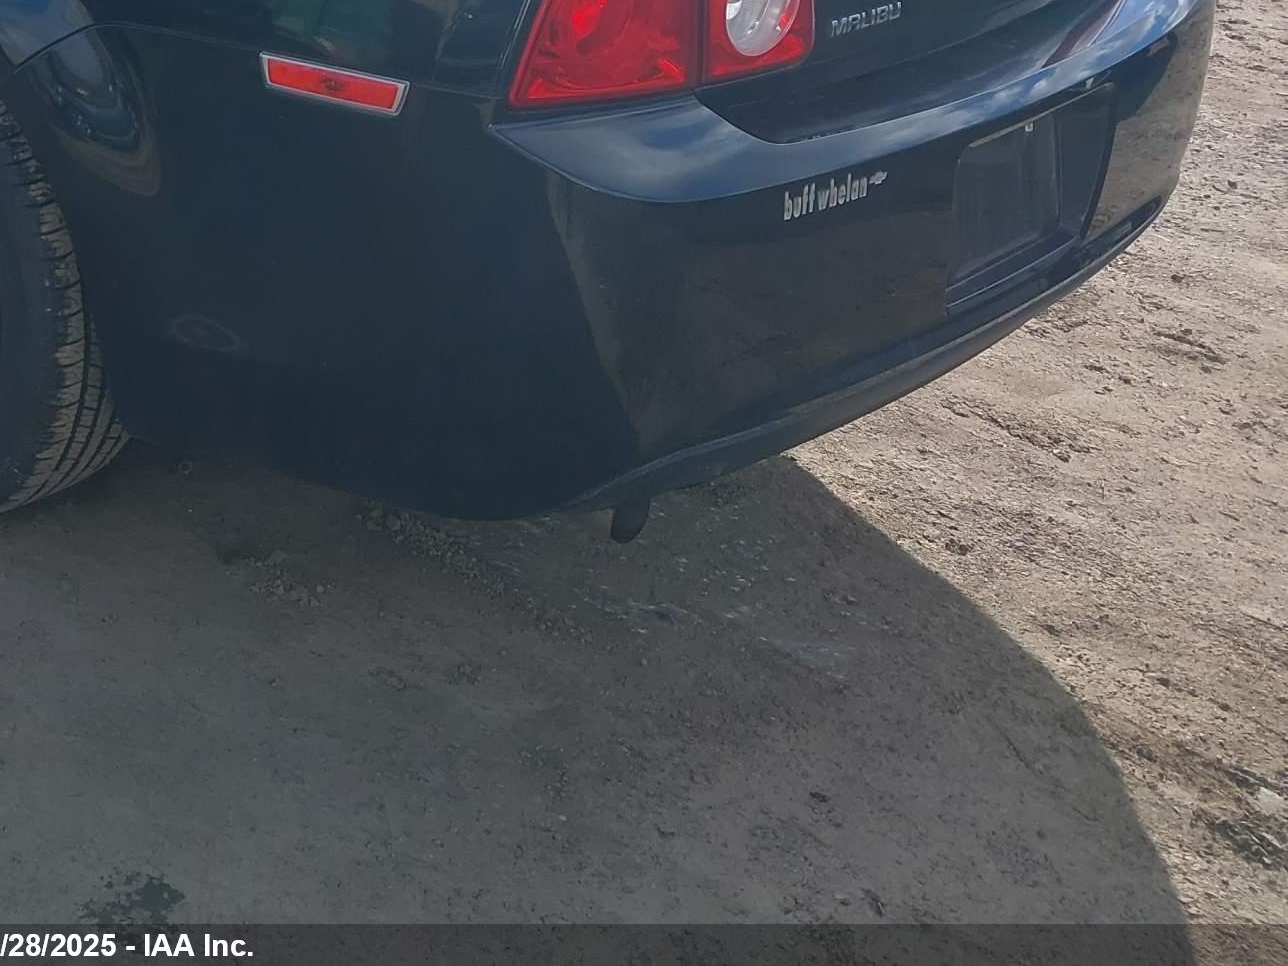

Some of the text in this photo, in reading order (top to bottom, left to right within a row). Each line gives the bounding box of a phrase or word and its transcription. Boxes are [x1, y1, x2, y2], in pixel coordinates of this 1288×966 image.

[831, 1, 902, 37] MALIBU
[784, 173, 868, 221] buff whelan
